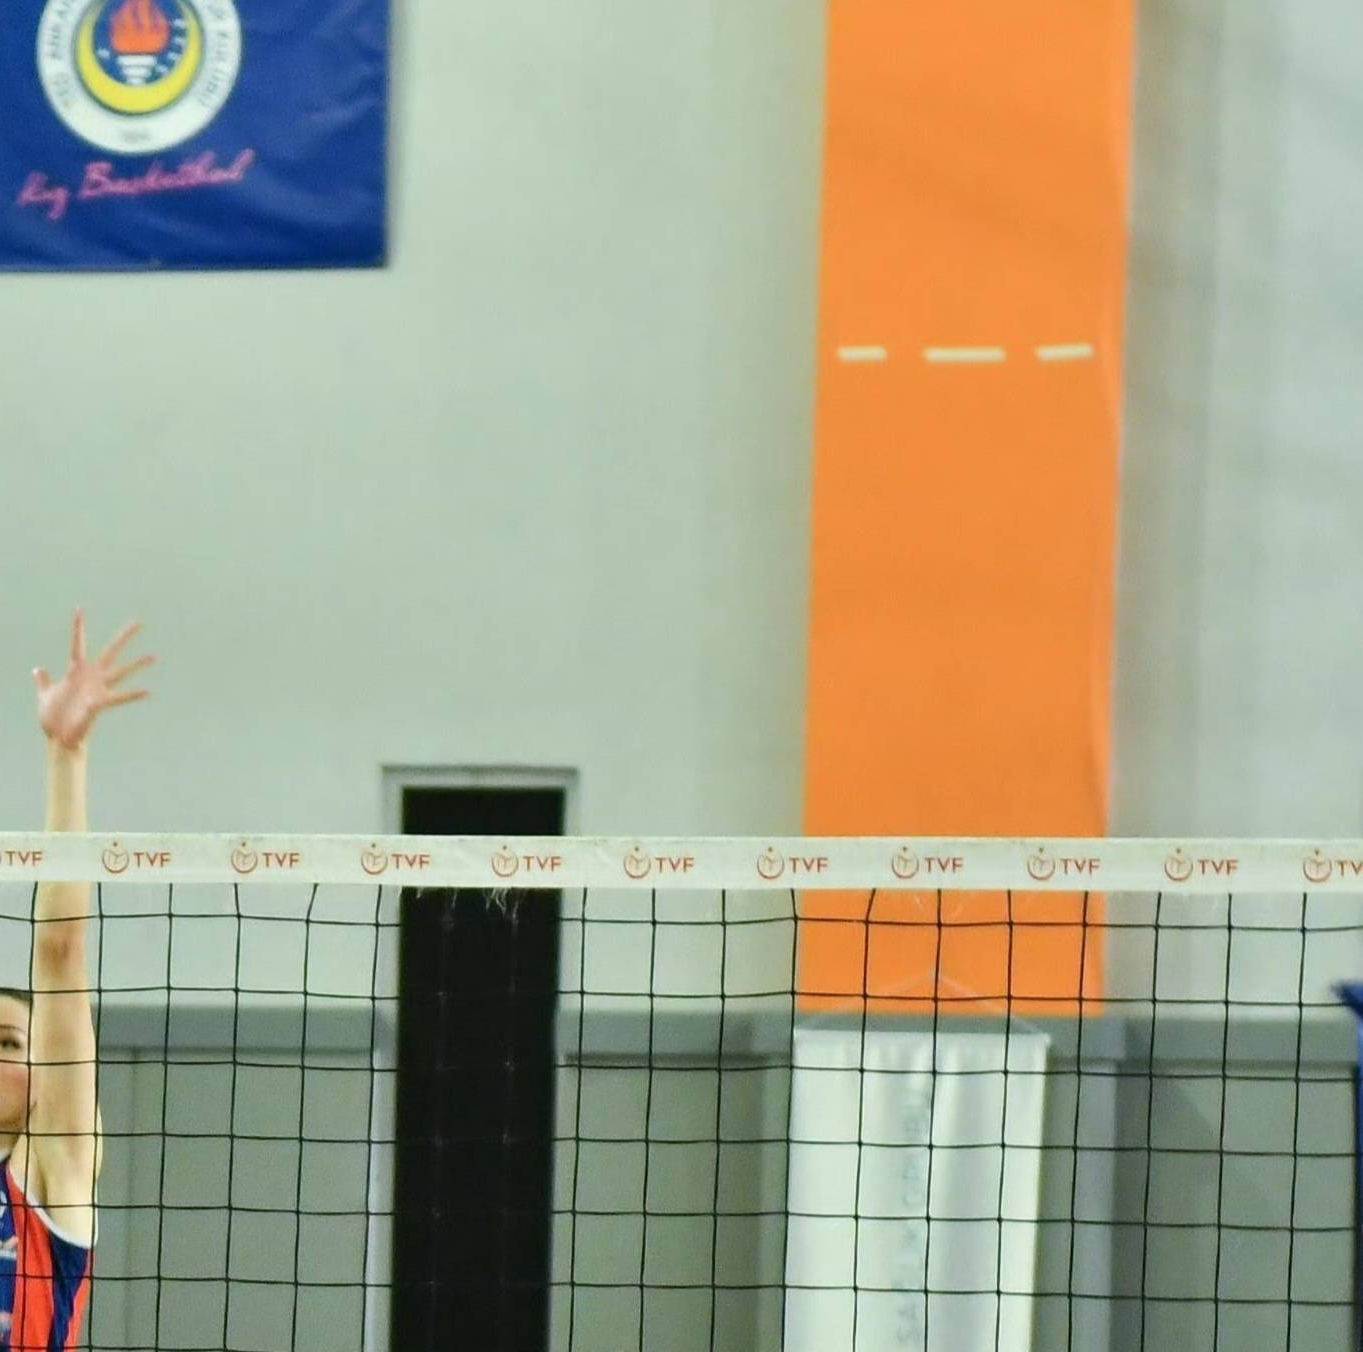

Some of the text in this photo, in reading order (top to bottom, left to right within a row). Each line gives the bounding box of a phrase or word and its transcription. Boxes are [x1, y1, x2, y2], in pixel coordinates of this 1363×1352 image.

[4, 850, 44, 867] TVF
[132, 851, 171, 868] TVF
[261, 851, 301, 869] TVF
[390, 852, 431, 870] TVF
[522, 855, 562, 872] TVF
[654, 856, 695, 873] TVF
[788, 856, 829, 874] TVF
[924, 856, 964, 874] TVF
[1059, 858, 1101, 876] TVF
[1197, 858, 1239, 876] TVF
